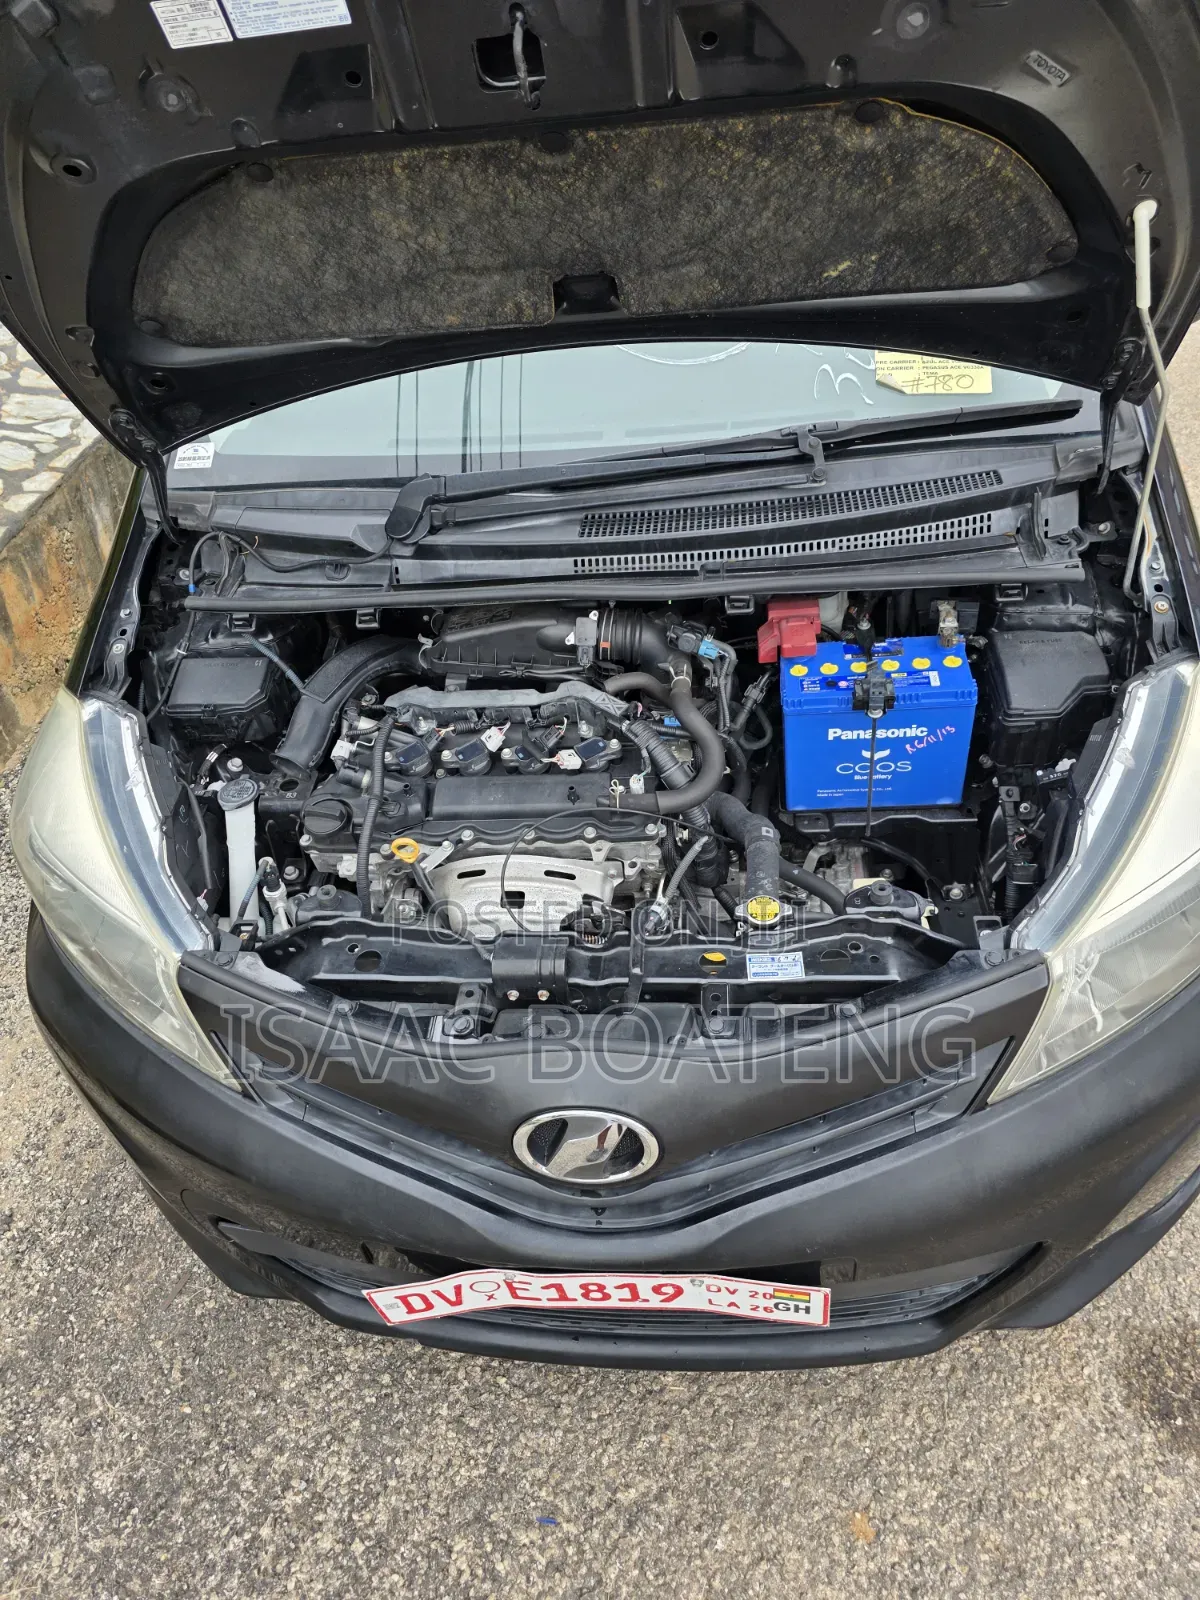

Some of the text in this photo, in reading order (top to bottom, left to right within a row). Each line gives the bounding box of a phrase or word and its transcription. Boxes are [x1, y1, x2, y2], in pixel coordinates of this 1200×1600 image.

[1032, 54, 1066, 81] TOYOTA
[901, 374, 974, 393] #780
[827, 724, 929, 740] Panasonic
[394, 1279, 774, 1315] DV E1819 DV 20
[707, 1298, 811, 1315] LA 26 GH
